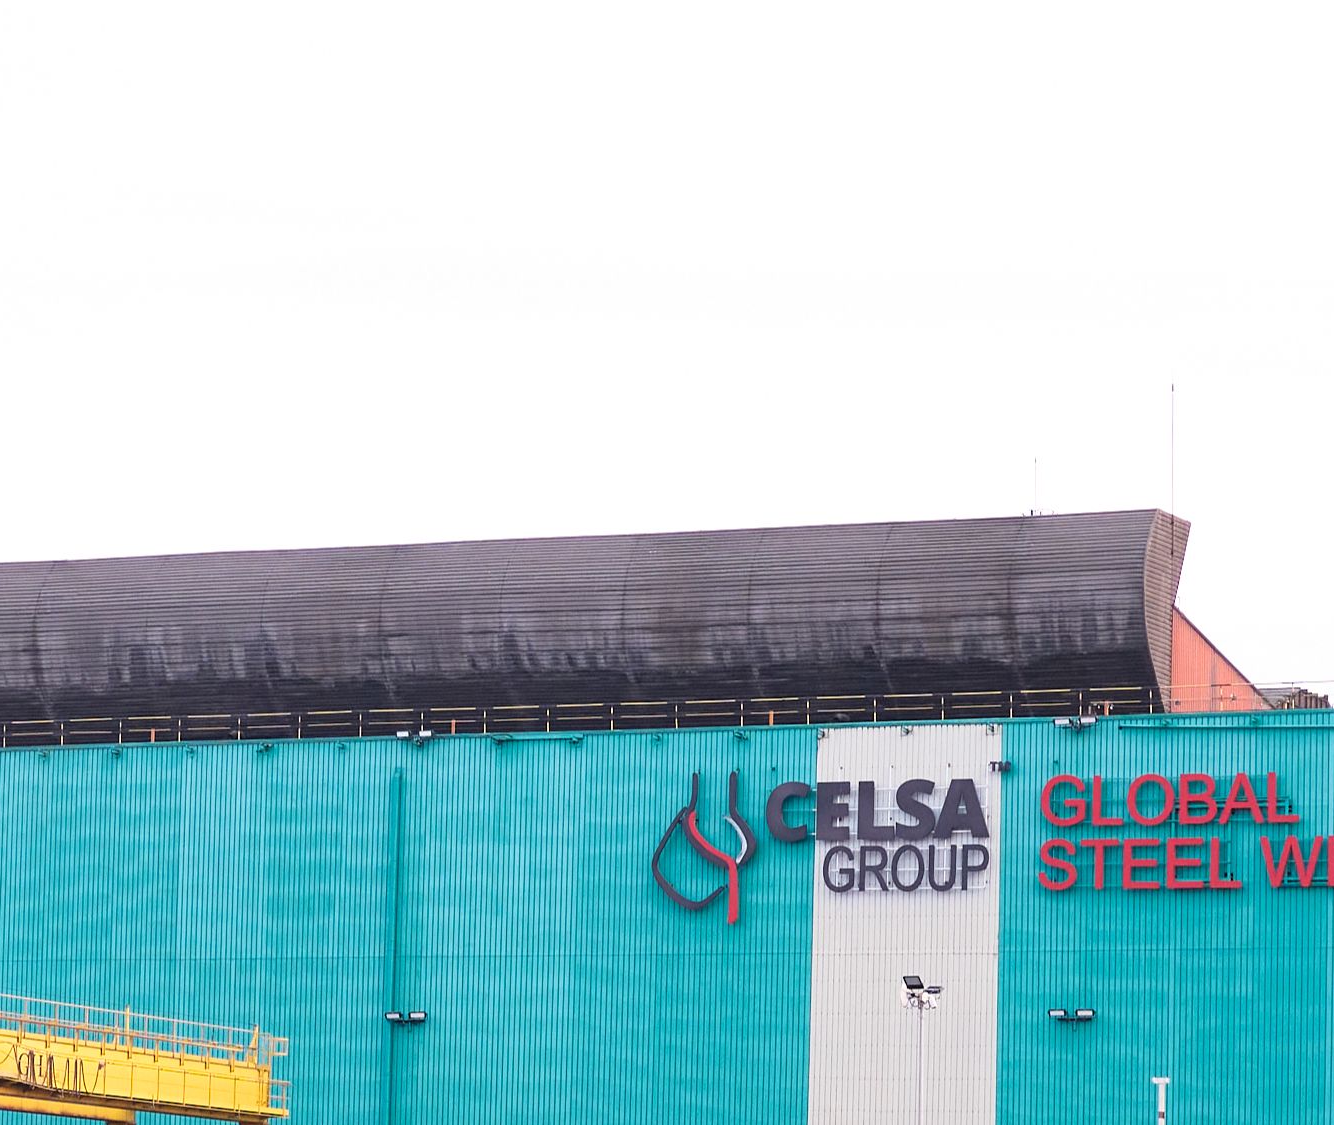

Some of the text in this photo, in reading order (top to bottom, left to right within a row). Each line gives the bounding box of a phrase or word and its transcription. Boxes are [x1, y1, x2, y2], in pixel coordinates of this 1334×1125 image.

[766, 778, 990, 842] CELSA
[1040, 772, 1300, 826] GLOBAL
[822, 844, 990, 893] GROUP
[1038, 837, 1242, 891] STEEL
